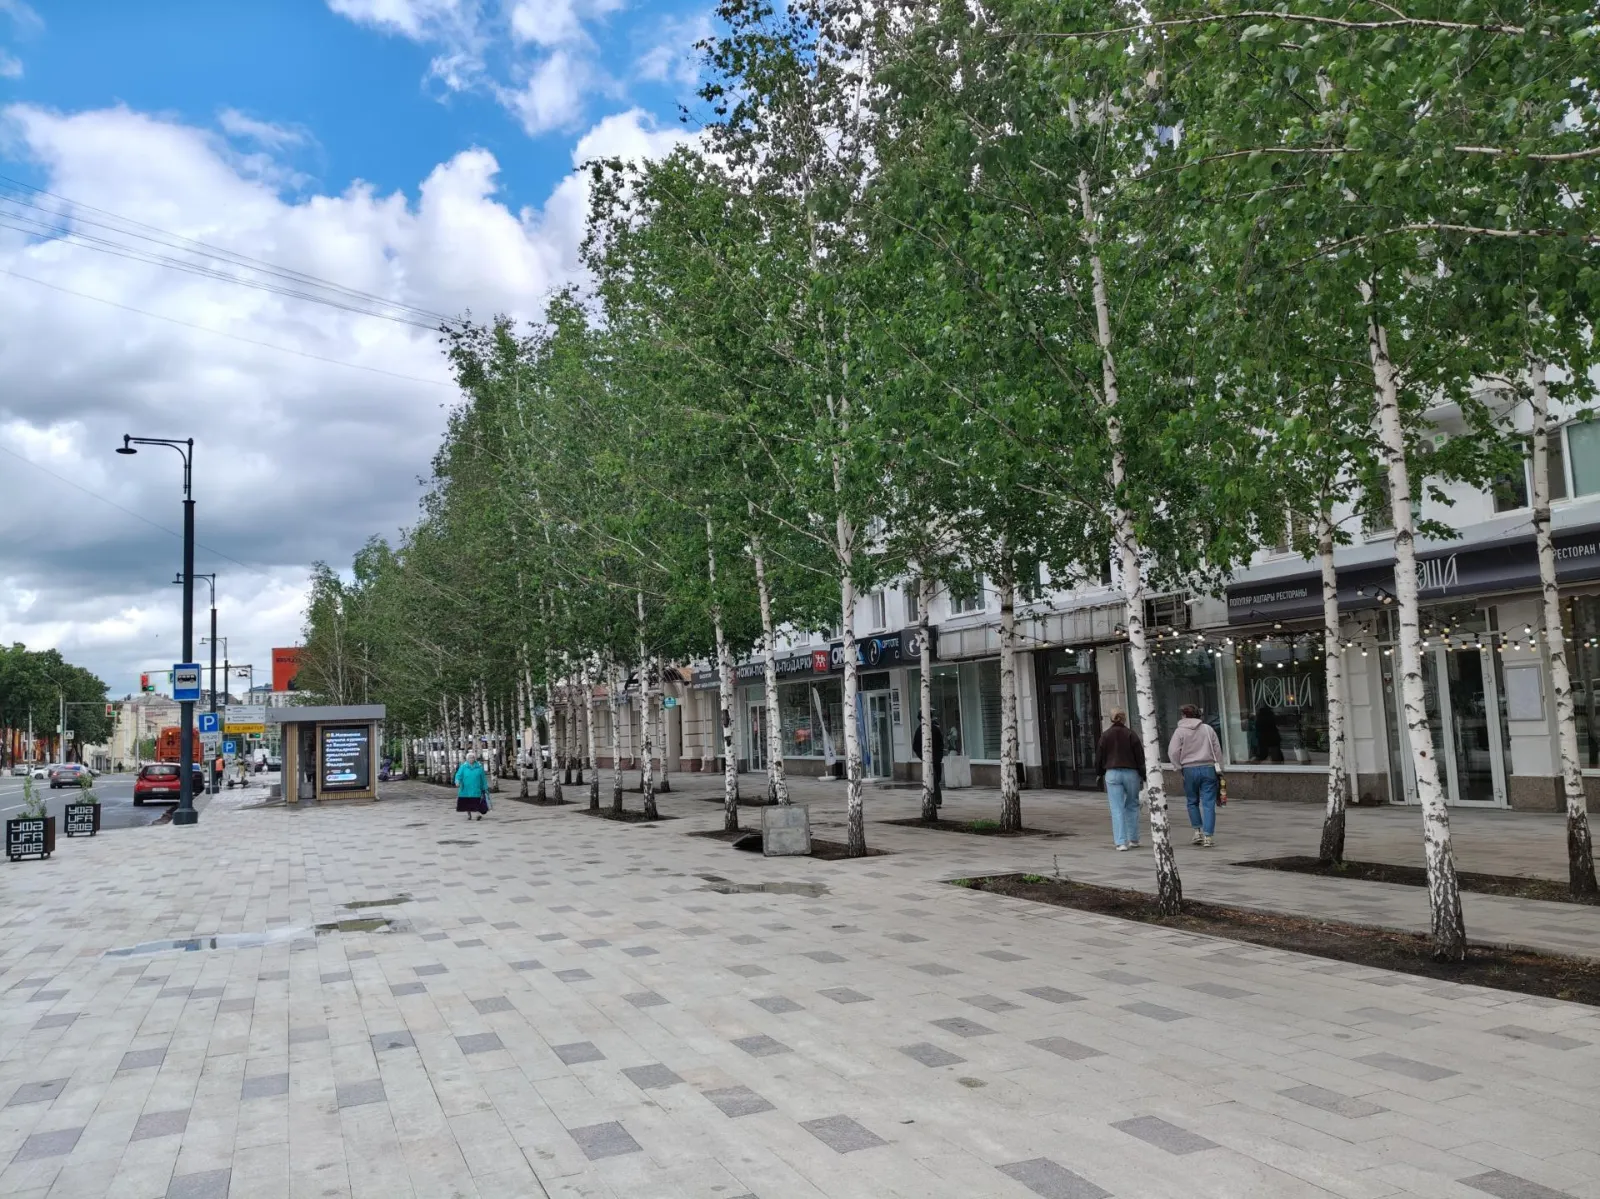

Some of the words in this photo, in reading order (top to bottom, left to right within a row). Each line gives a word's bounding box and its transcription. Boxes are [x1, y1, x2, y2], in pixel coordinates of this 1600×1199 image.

[1552, 543, 1596, 561] РЕСТОРАН
[1276, 588, 1308, 600] РЕСТОРАНЫ
[736, 656, 813, 679] НОЖИ-ПОА-ПОДАРКИ
[68, 814, 93, 823] UFA
[11, 831, 44, 844] UFA
